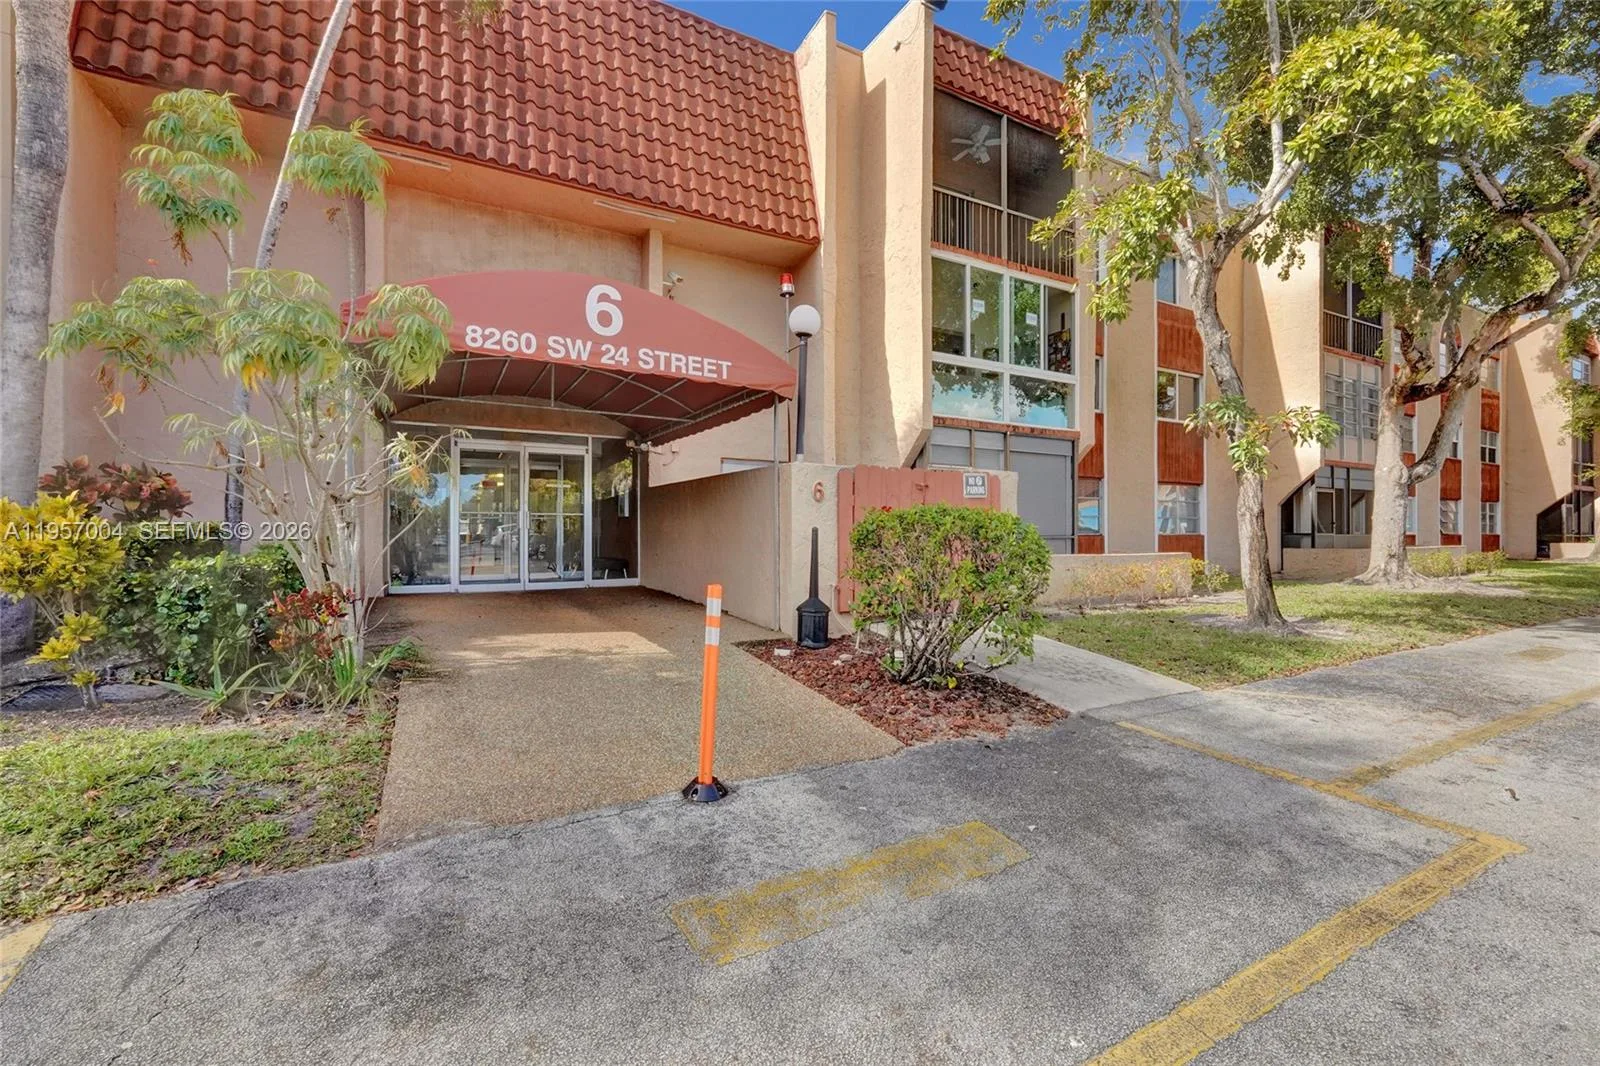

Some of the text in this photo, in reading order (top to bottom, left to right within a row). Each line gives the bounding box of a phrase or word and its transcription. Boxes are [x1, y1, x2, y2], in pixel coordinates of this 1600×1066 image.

[586, 284, 623, 336] 6
[465, 325, 732, 379] 8260 SW 24 STREET
[812, 480, 825, 503] 6
